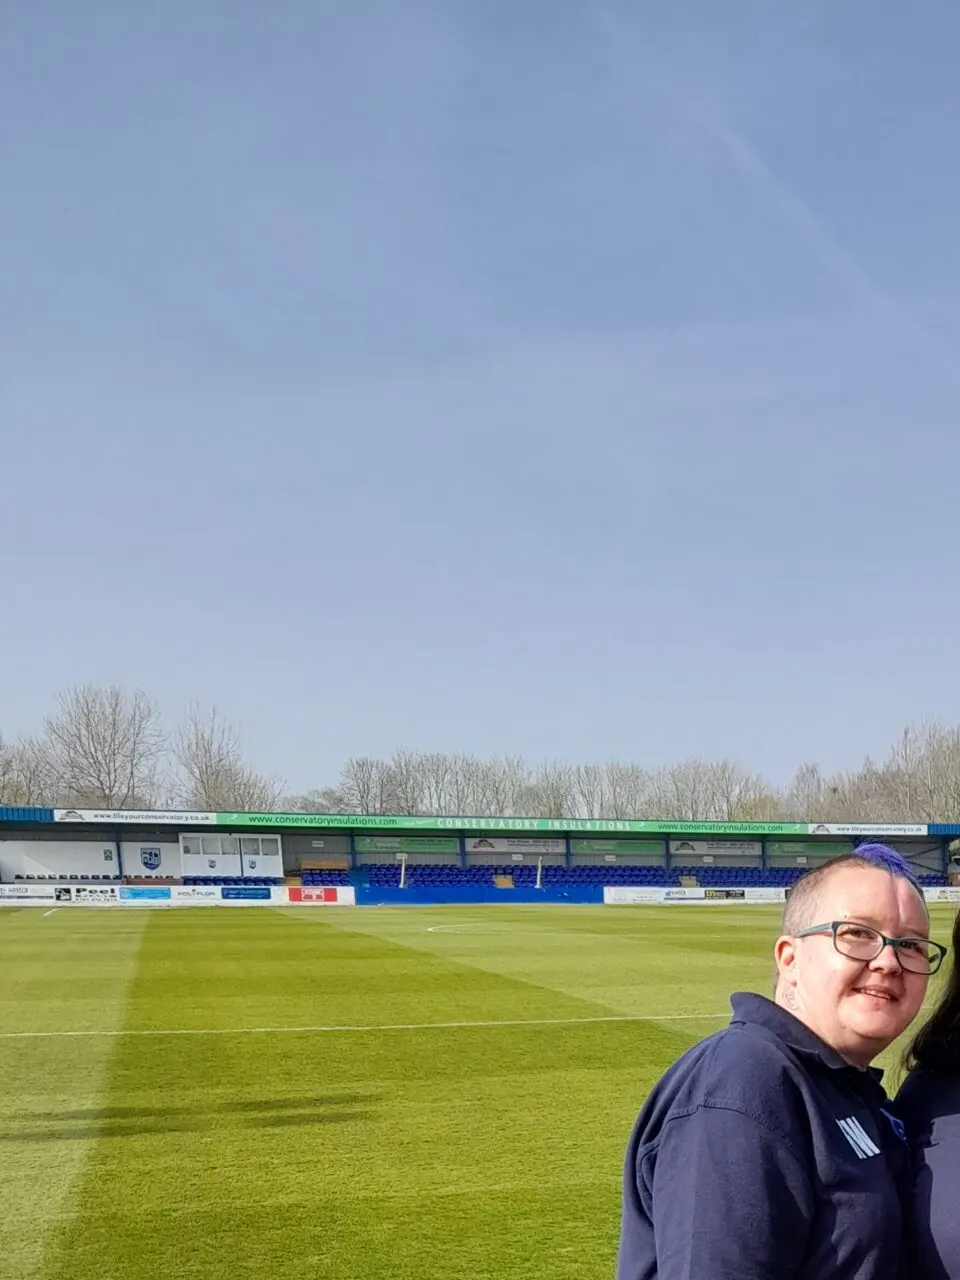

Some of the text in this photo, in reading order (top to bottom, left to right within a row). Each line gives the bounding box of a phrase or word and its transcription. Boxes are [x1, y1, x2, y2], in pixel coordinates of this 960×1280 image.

[248, 814, 397, 826] www.conservatoryinsulations.com
[437, 819, 539, 829] CONSERVATORY
[548, 820, 631, 830] INSULATIONS
[657, 823, 783, 832] www.conservatoryinsulations.com
